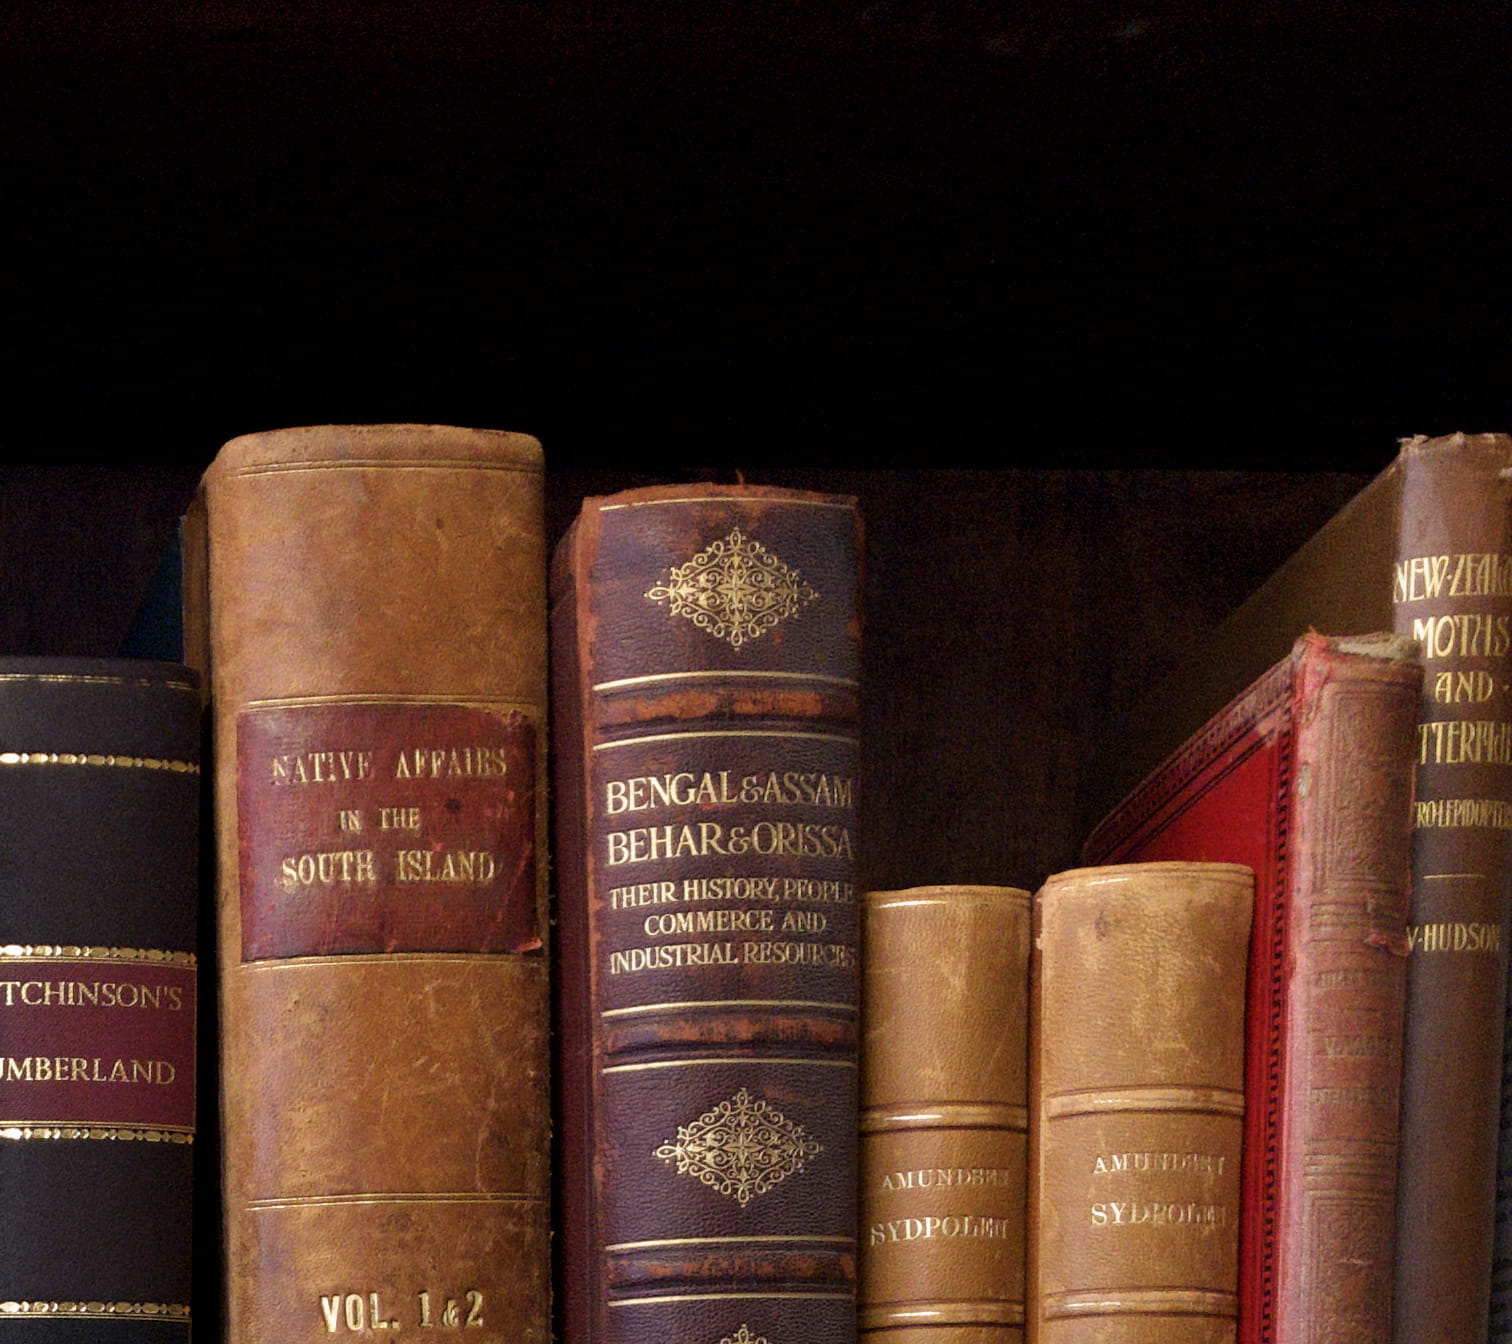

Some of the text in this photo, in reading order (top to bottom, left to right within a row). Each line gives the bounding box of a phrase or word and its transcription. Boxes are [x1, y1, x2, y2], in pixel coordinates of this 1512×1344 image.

[1413, 614, 1510, 659] MOTHS
[1435, 671, 1494, 703] AND
[272, 746, 509, 785] NATIVE AFFAIRS
[606, 770, 738, 815] BENGAL
[764, 771, 853, 809] ASSAM
[339, 806, 421, 832] IN THE
[607, 822, 729, 866] BEHAR
[752, 822, 855, 860] ORISSA
[275, 848, 496, 887] SOUTH ISLAND
[608, 881, 678, 910] THEIR
[644, 910, 827, 936] COMMERCE AND
[609, 942, 738, 975] INDUSTRIAL
[320, 1293, 401, 1334] VOL.
